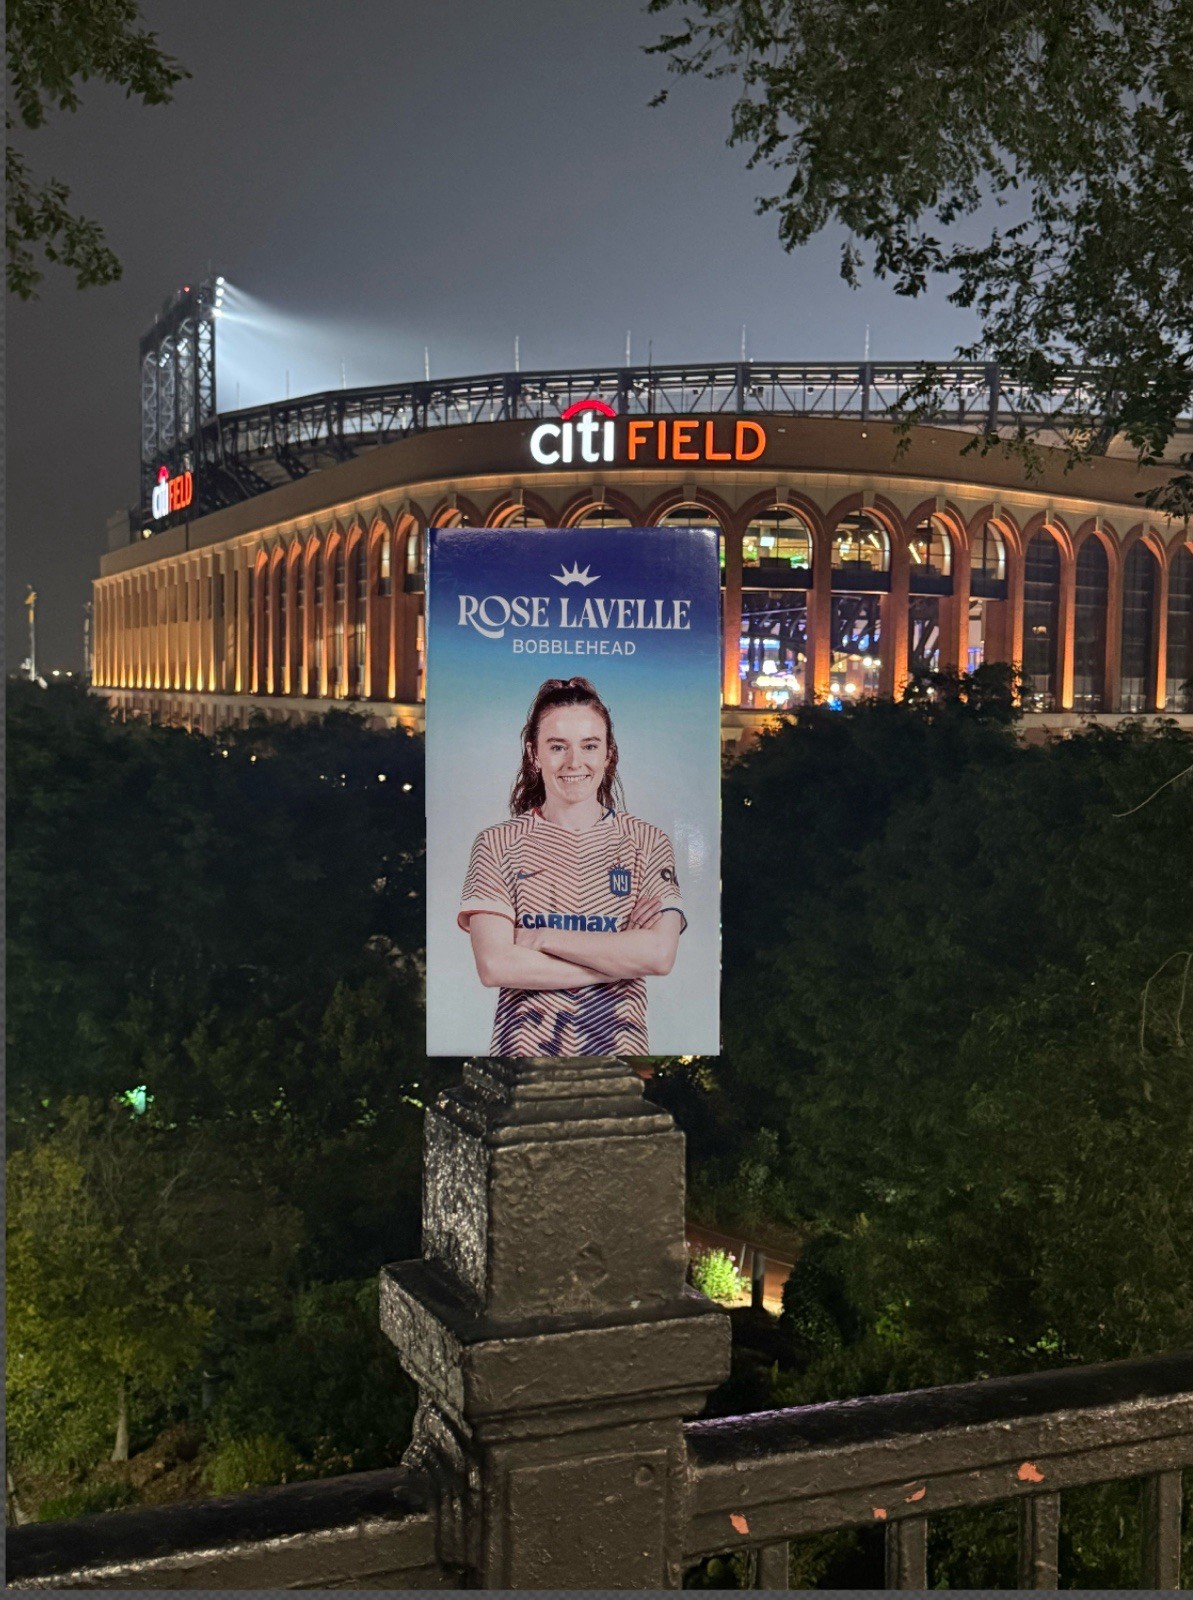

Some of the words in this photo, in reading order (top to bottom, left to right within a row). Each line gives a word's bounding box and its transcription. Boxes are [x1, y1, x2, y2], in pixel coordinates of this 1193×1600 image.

[530, 399, 616, 465] citi
[628, 420, 767, 461] FIELD
[458, 594, 550, 639] ROSE
[559, 597, 691, 630] LAVELLE
[512, 639, 637, 656] BOBBLEHEAD
